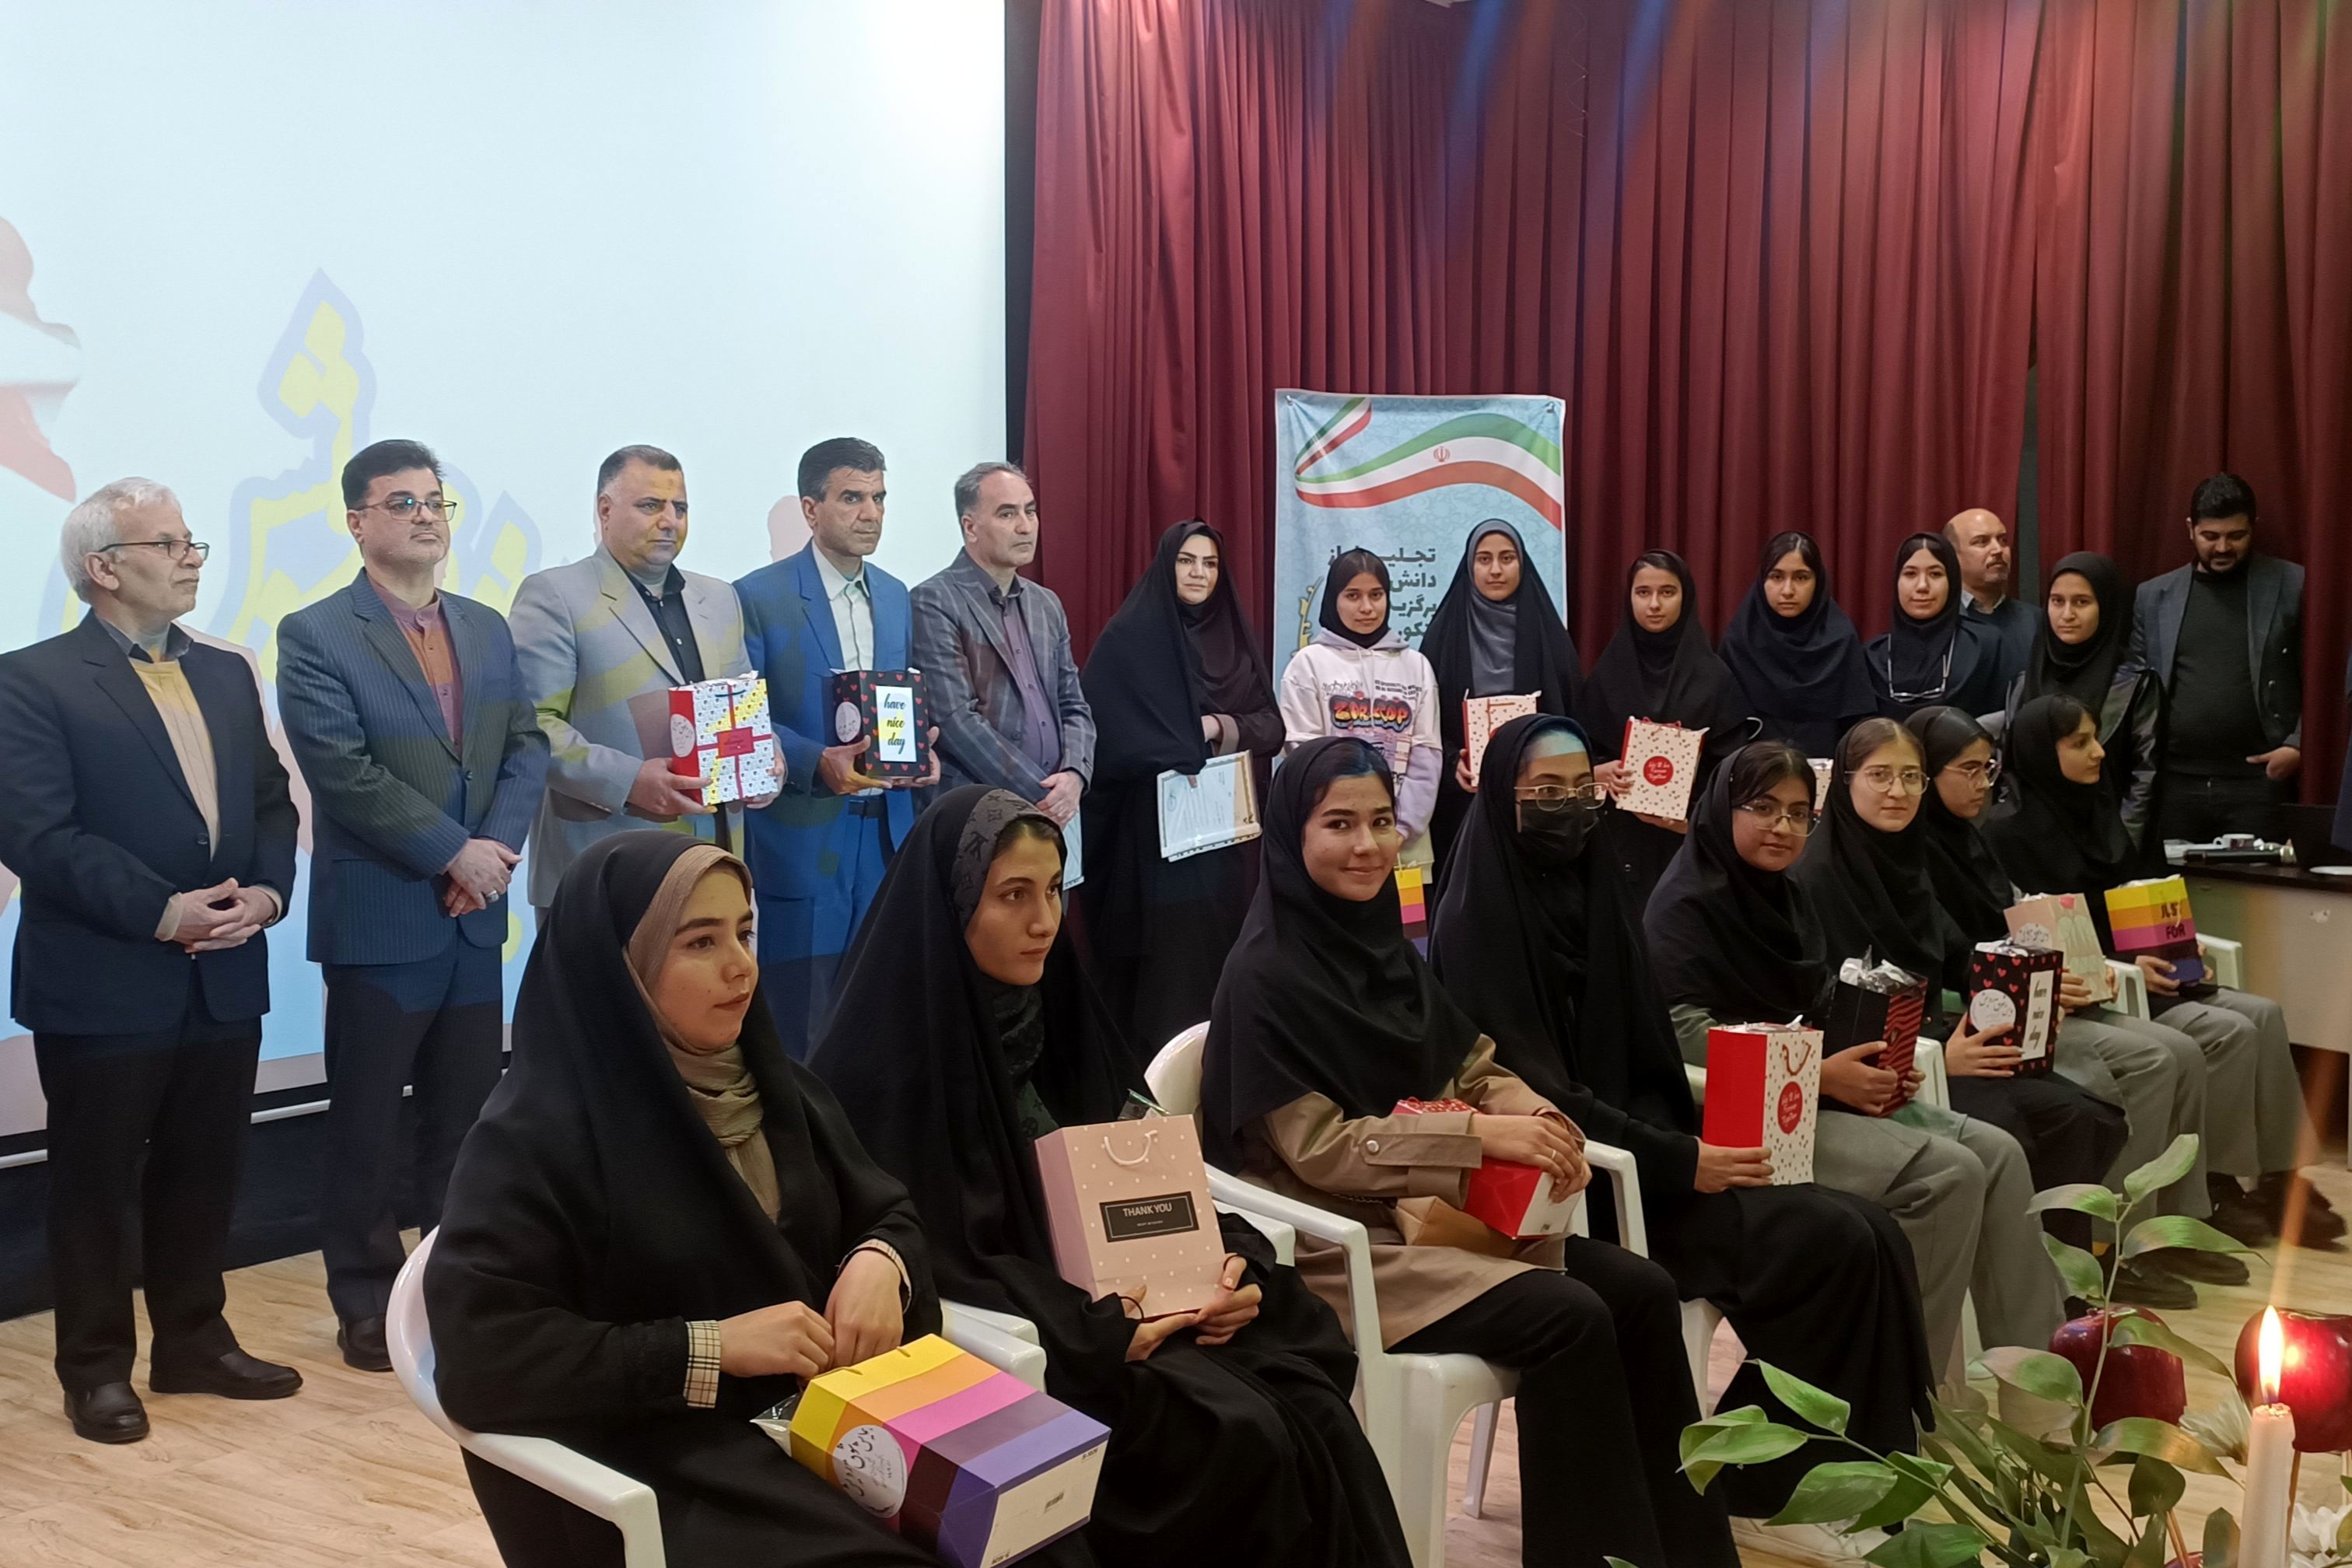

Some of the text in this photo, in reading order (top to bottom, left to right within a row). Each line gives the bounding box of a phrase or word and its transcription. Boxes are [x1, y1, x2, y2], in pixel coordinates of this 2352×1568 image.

[1381, 547, 1436, 567] تجلی
[884, 693, 906, 709] have
[887, 716, 905, 728] nice
[887, 732, 905, 754] day
[2165, 922, 2186, 940] FOR
[1122, 1202, 1172, 1217] THANK YOU
